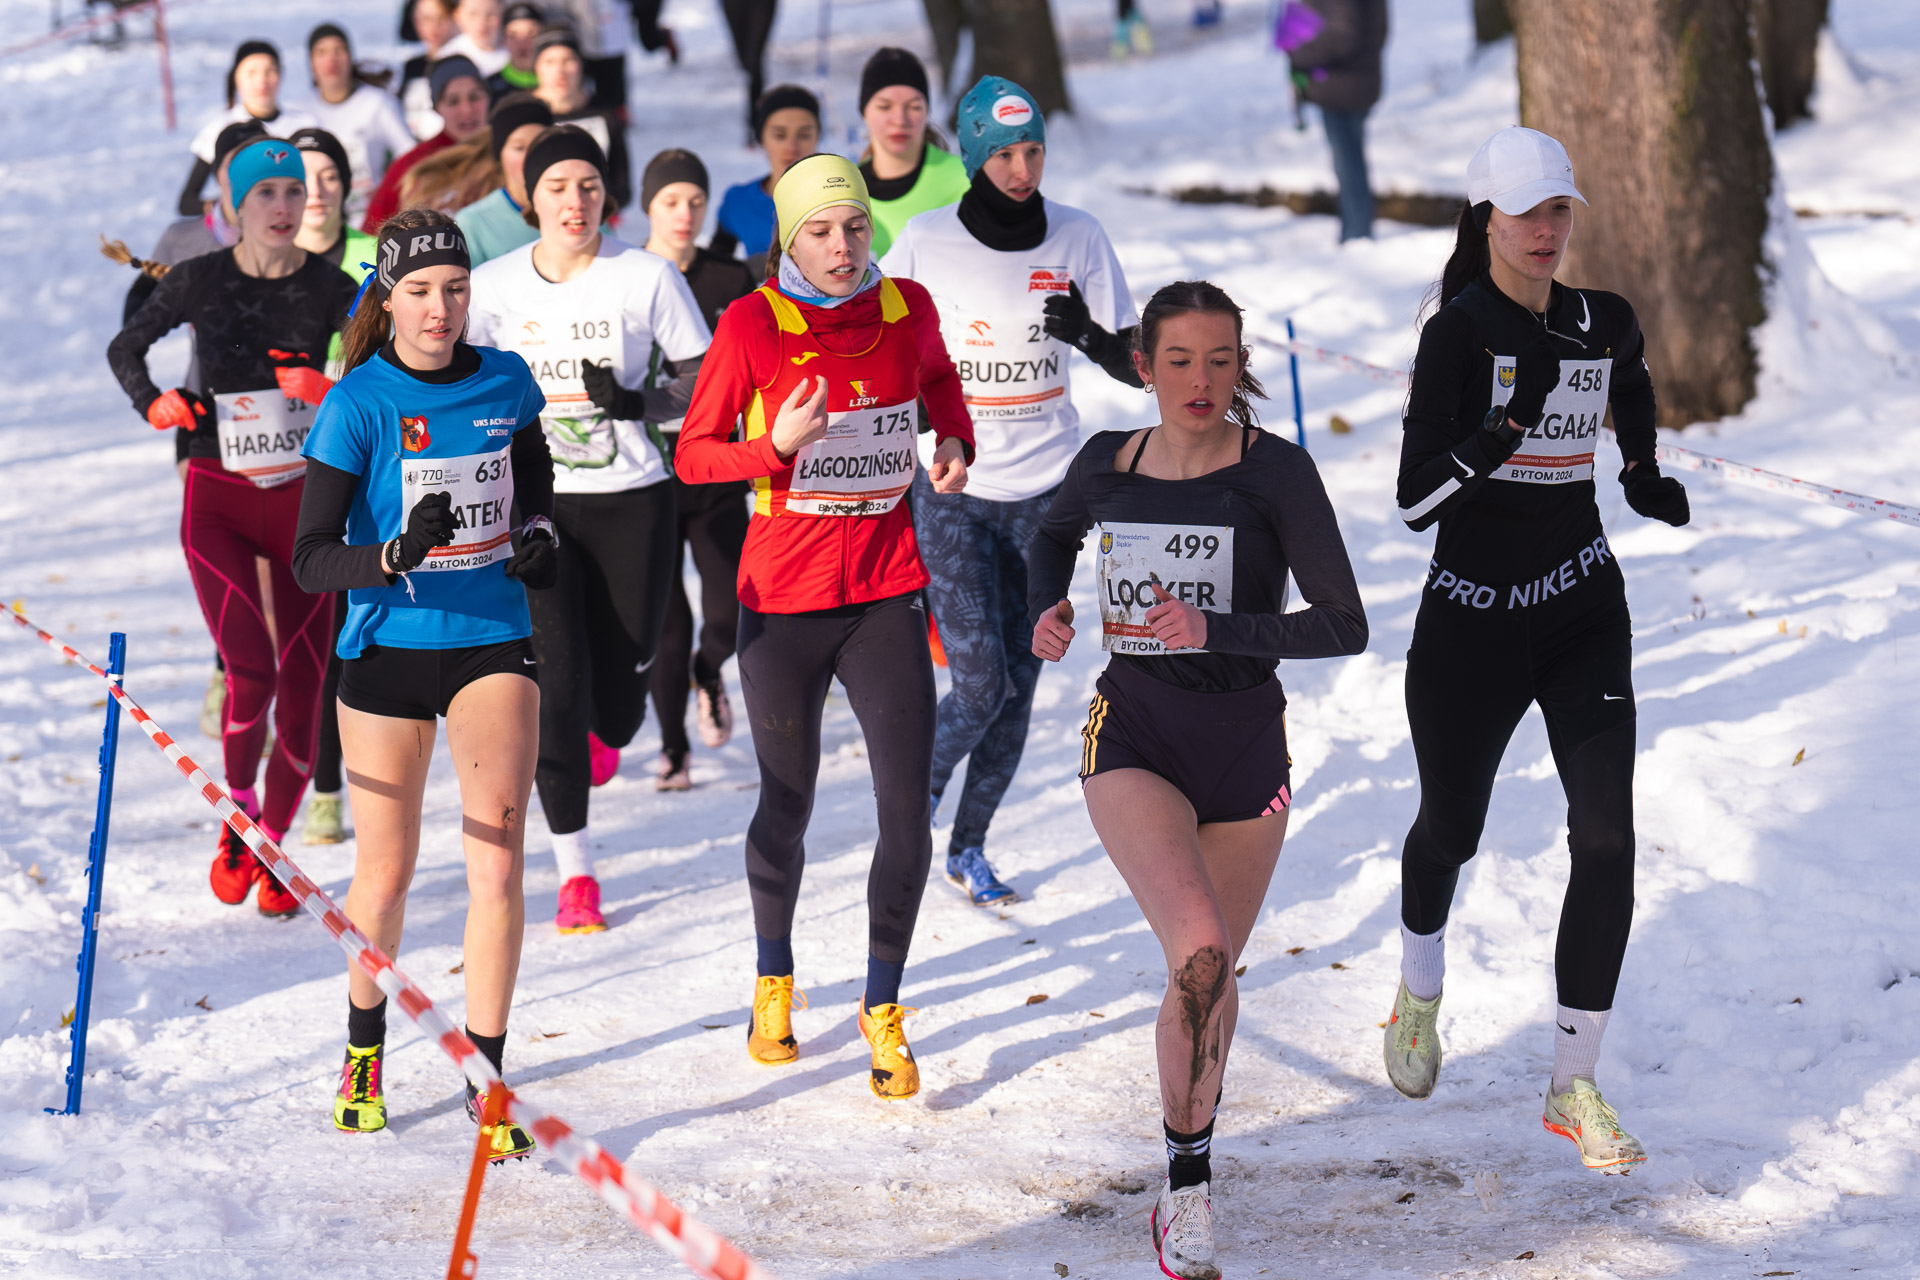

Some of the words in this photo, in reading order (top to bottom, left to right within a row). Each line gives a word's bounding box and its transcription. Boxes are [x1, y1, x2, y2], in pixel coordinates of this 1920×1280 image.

[571, 321, 610, 340] 103
[1027, 324, 1051, 343] 2
[966, 338, 994, 347] ORLEN
[531, 357, 612, 381] MACI
[960, 351, 1058, 383] BUDZYŃ
[1567, 368, 1603, 392] 458
[849, 396, 879, 408] LISY
[977, 408, 1016, 417] BYTOM
[1018, 404, 1042, 415] 2024
[472, 418, 489, 428] UKS
[489, 417, 516, 426] ACHILLES
[486, 428, 509, 437] LESZNO
[873, 409, 910, 436] 175
[1527, 412, 1598, 439] ZGAŁA
[226, 426, 310, 456] HARASY
[475, 456, 508, 483] 637
[799, 448, 913, 479] ŁAGODZIŃSKA
[421, 469, 443, 481] 770
[1511, 469, 1554, 481] BYTOM
[1555, 470, 1574, 480] 2024
[453, 497, 505, 529] ATEK
[1165, 534, 1220, 560] 499
[430, 558, 471, 569] BYTOM
[473, 553, 493, 566] 2024
[1431, 569, 1497, 609] PRO
[1507, 559, 1577, 610] NIKE
[1120, 640, 1161, 651] BYTOM
